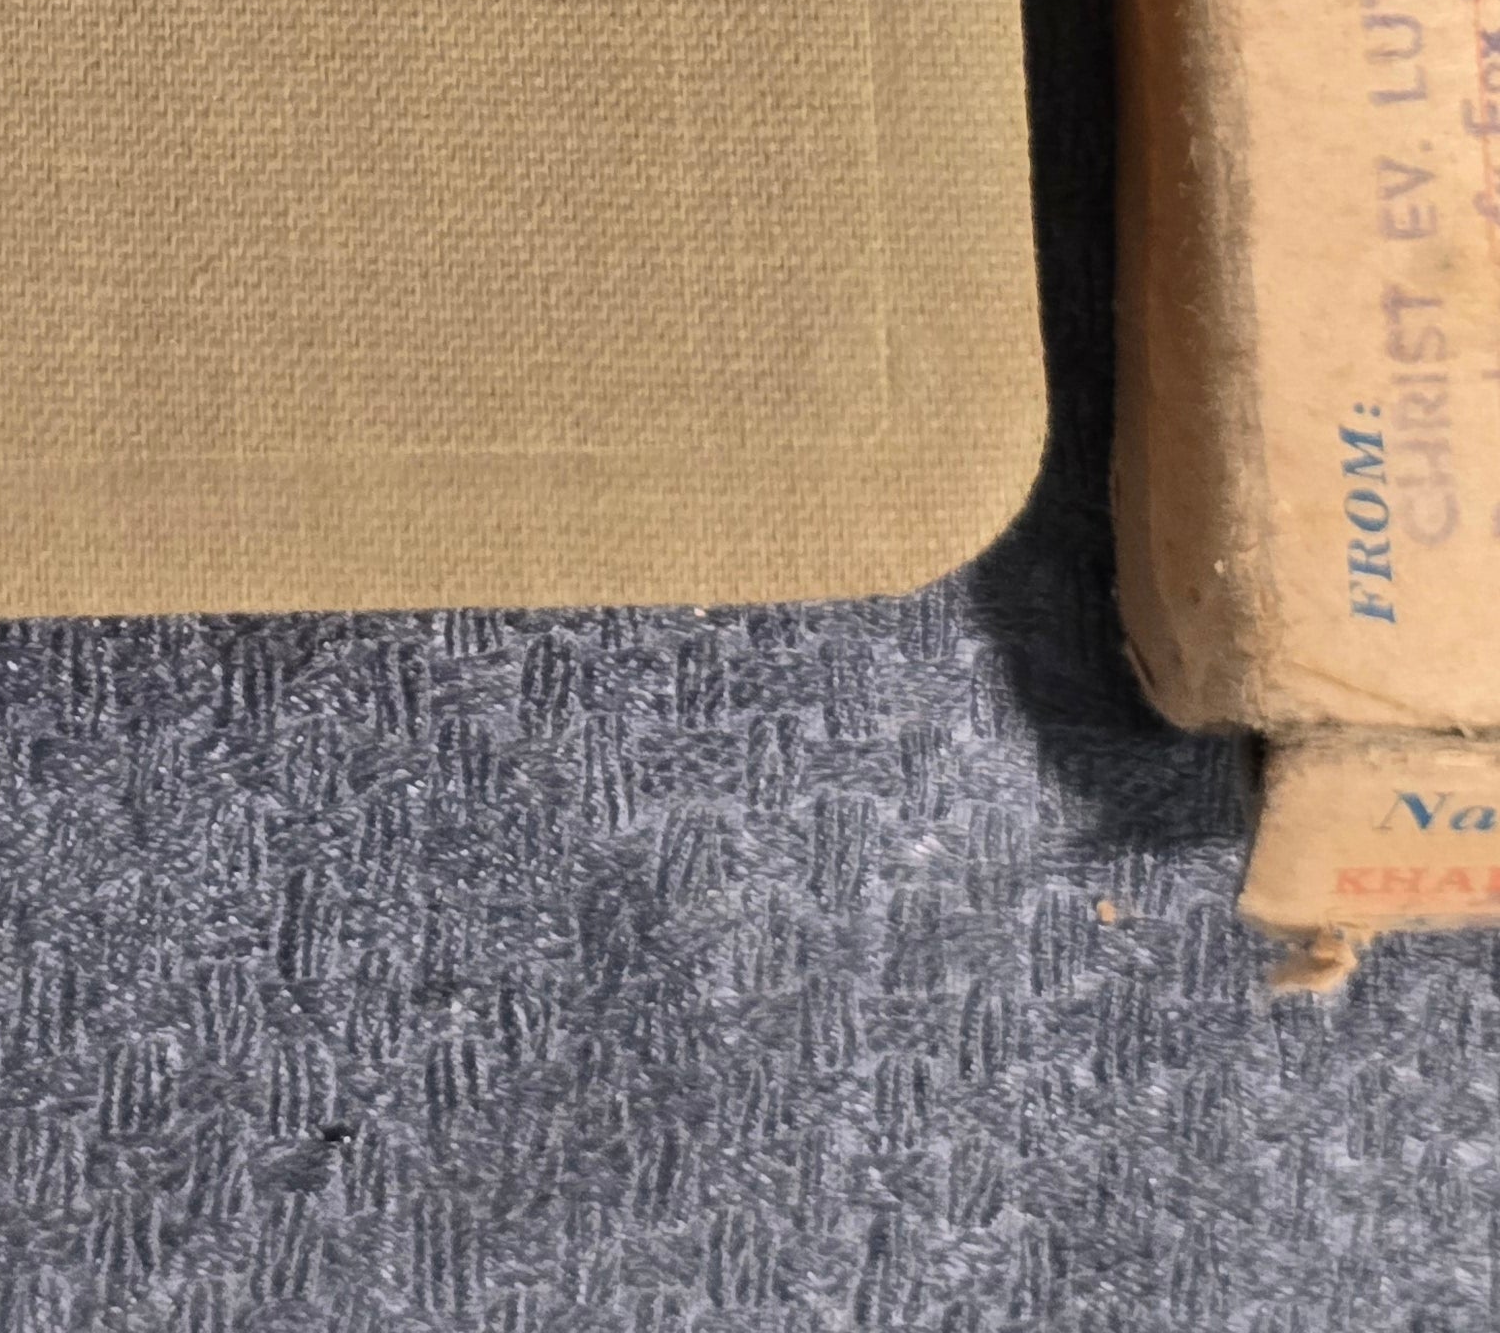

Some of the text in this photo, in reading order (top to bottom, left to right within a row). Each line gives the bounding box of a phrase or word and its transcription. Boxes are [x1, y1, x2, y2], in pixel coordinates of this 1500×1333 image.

[1377, 139, 1438, 240] EV.
[1337, 399, 1398, 625] FROM:
[1381, 283, 1459, 547] CHRIST
